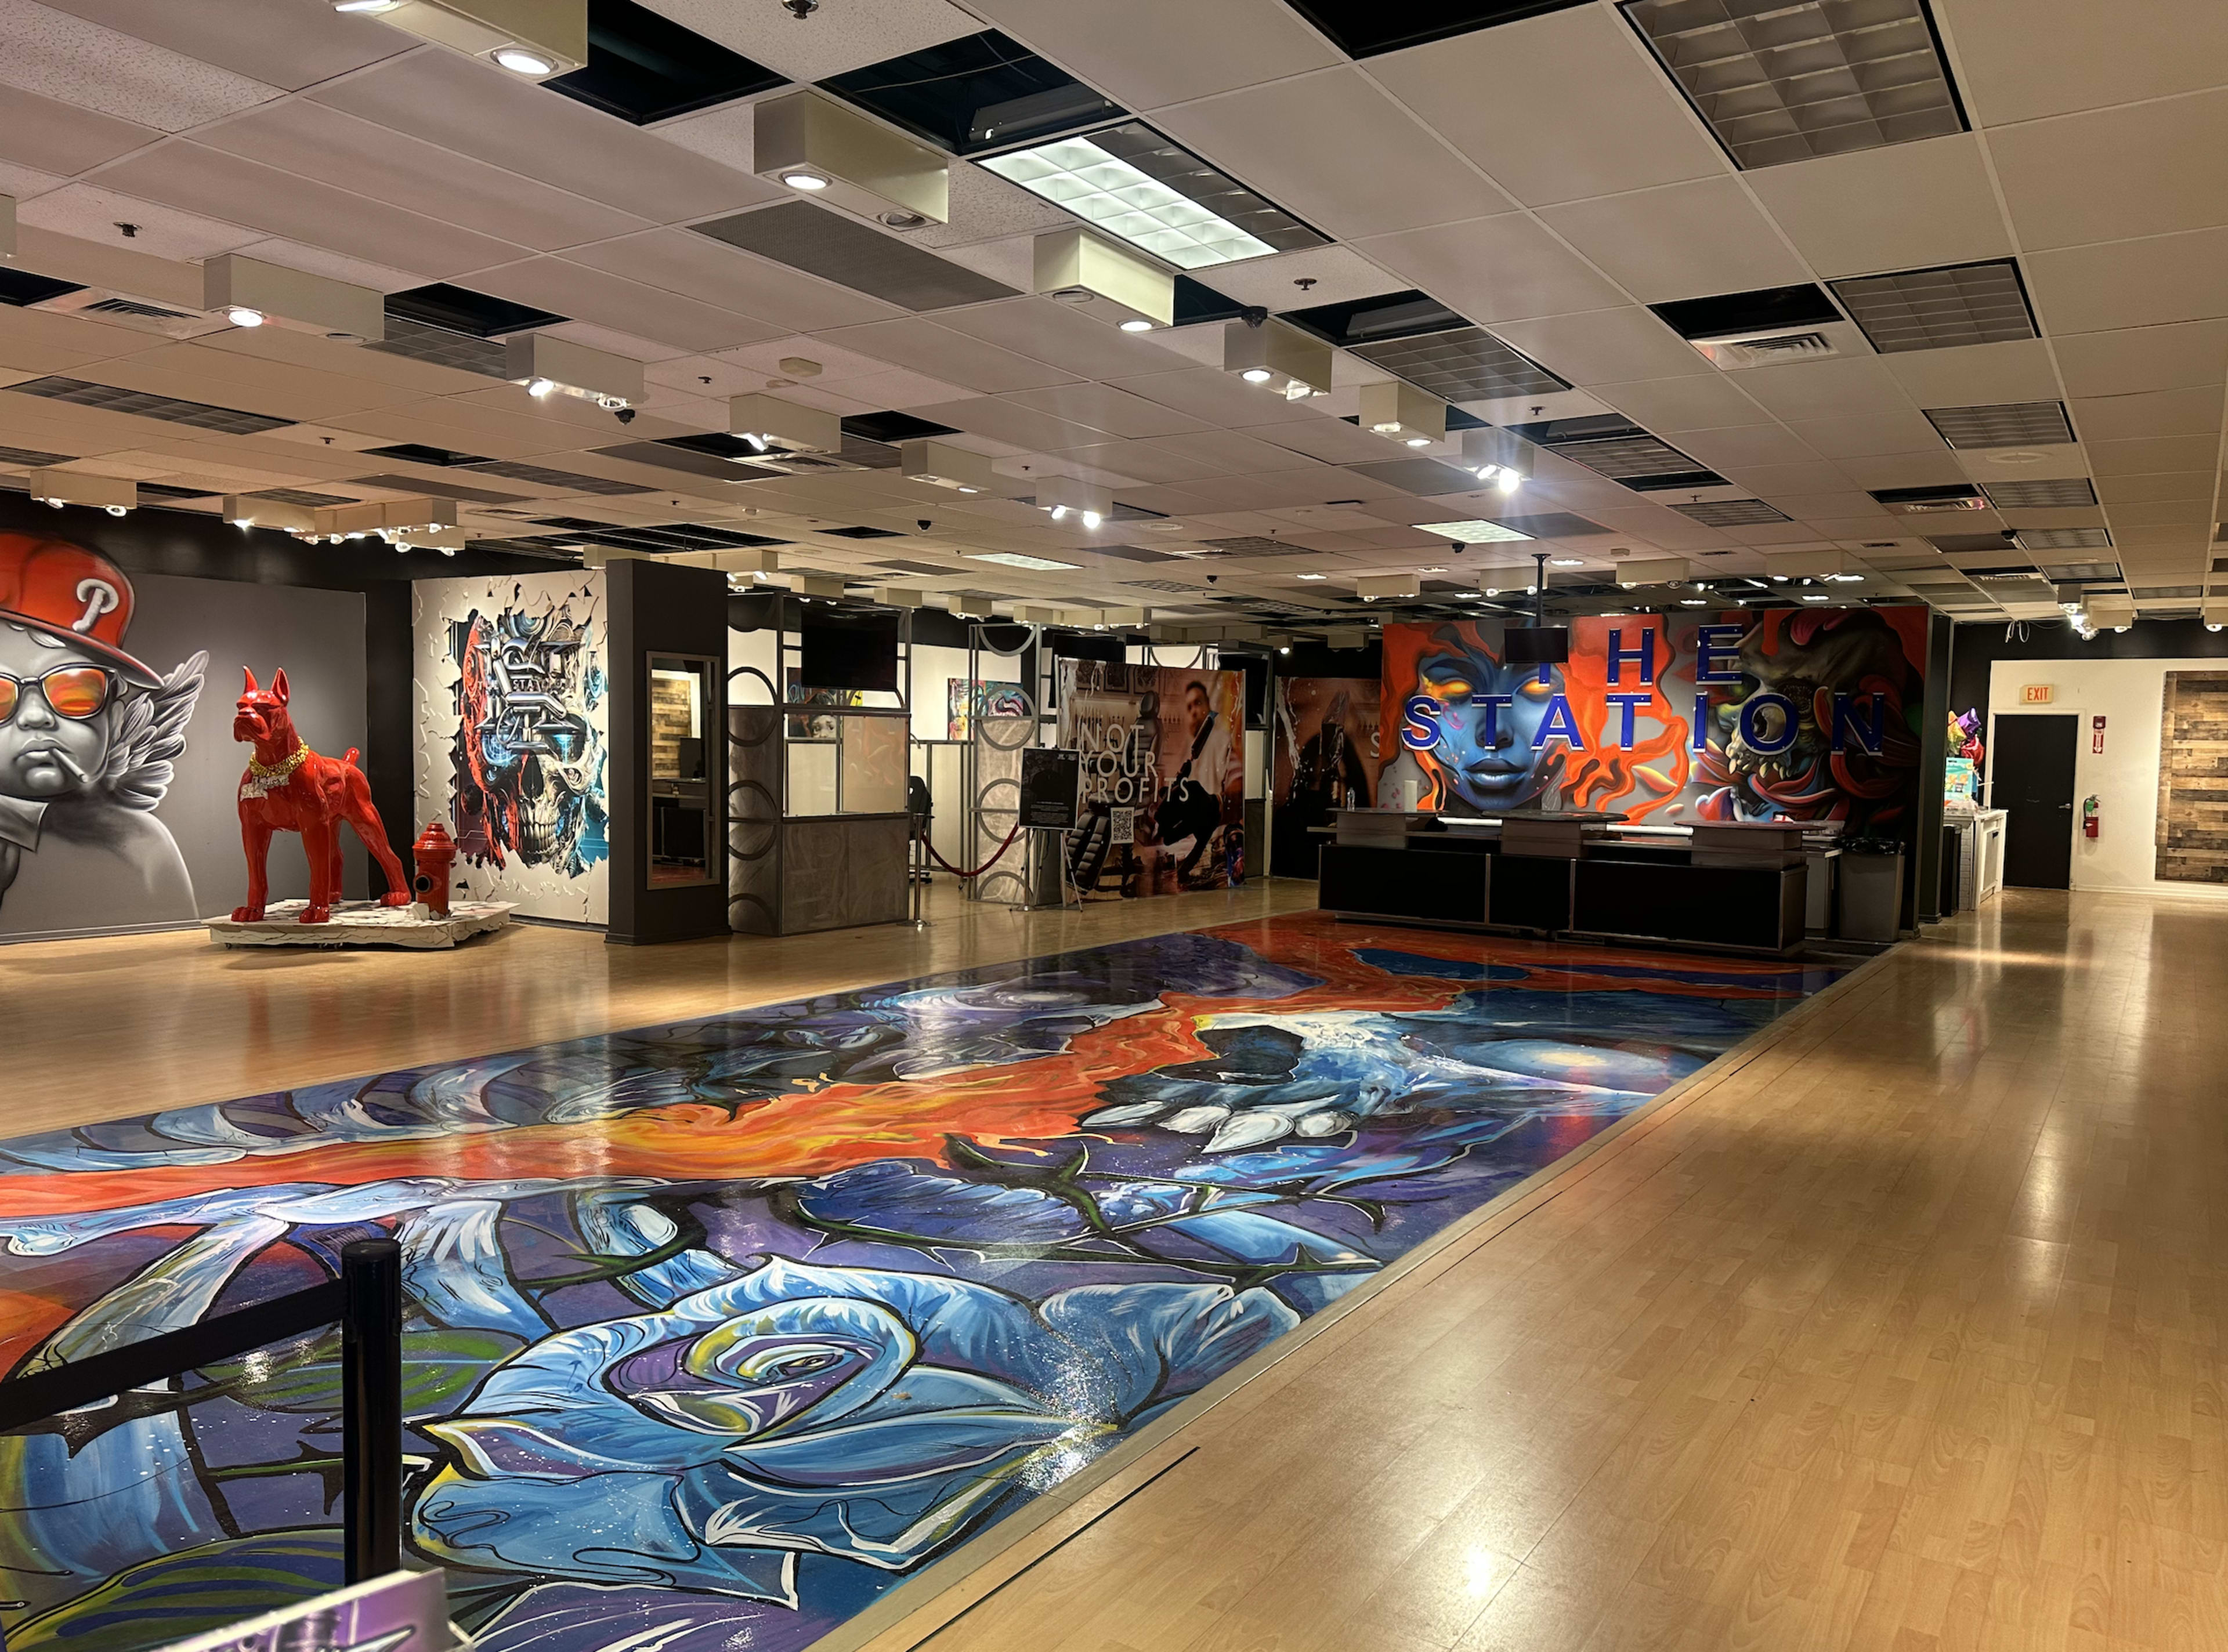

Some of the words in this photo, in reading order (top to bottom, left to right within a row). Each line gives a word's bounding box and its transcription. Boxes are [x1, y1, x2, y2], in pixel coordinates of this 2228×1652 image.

[73, 579, 119, 632] P
[2027, 686, 2049, 701] EXIT
[1401, 692, 1884, 756] STATION
[1081, 749, 1158, 777] YOUR
[1082, 777, 1189, 805] PROFITS
